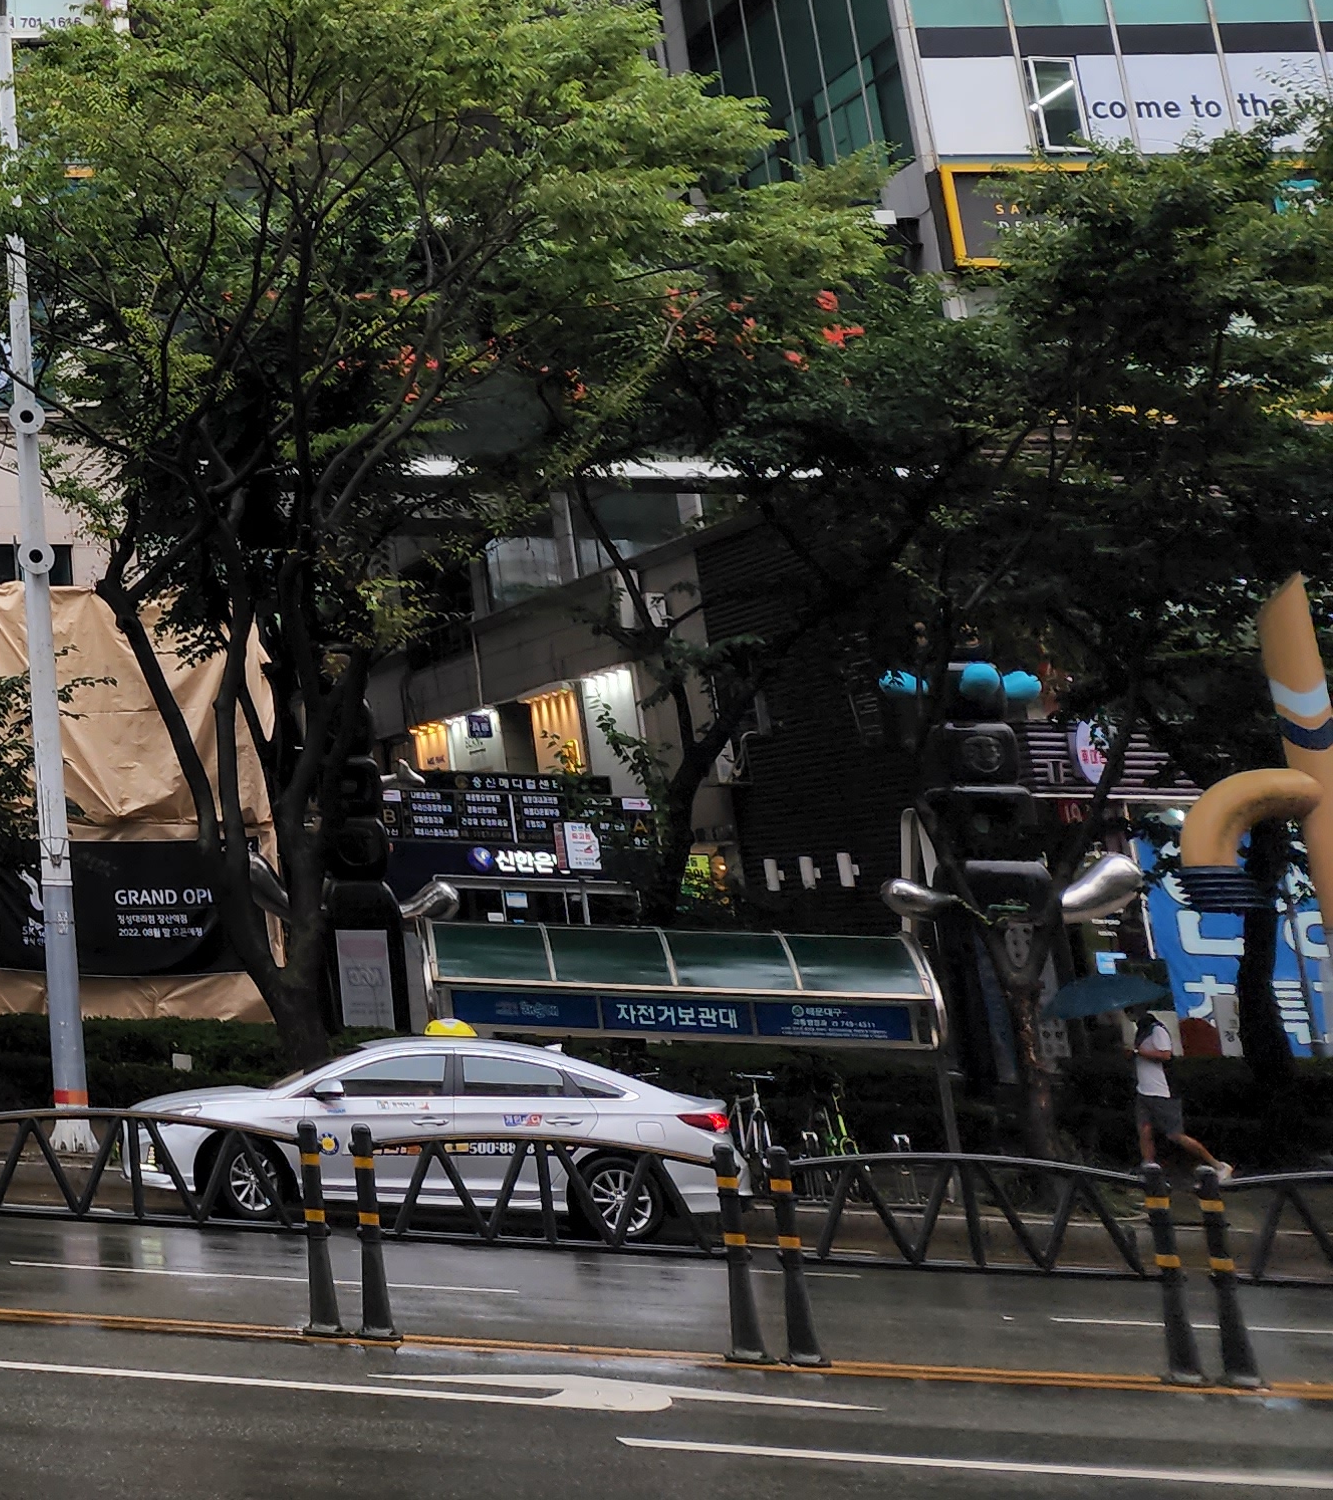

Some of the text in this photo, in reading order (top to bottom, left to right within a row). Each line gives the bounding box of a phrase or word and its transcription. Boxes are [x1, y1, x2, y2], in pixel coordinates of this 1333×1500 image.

[1088, 96, 1182, 120] come
[1191, 97, 1222, 120] to
[495, 850, 570, 874] 신한은
[114, 888, 178, 906] GRAND
[616, 1002, 740, 1029] 자전거보관대
